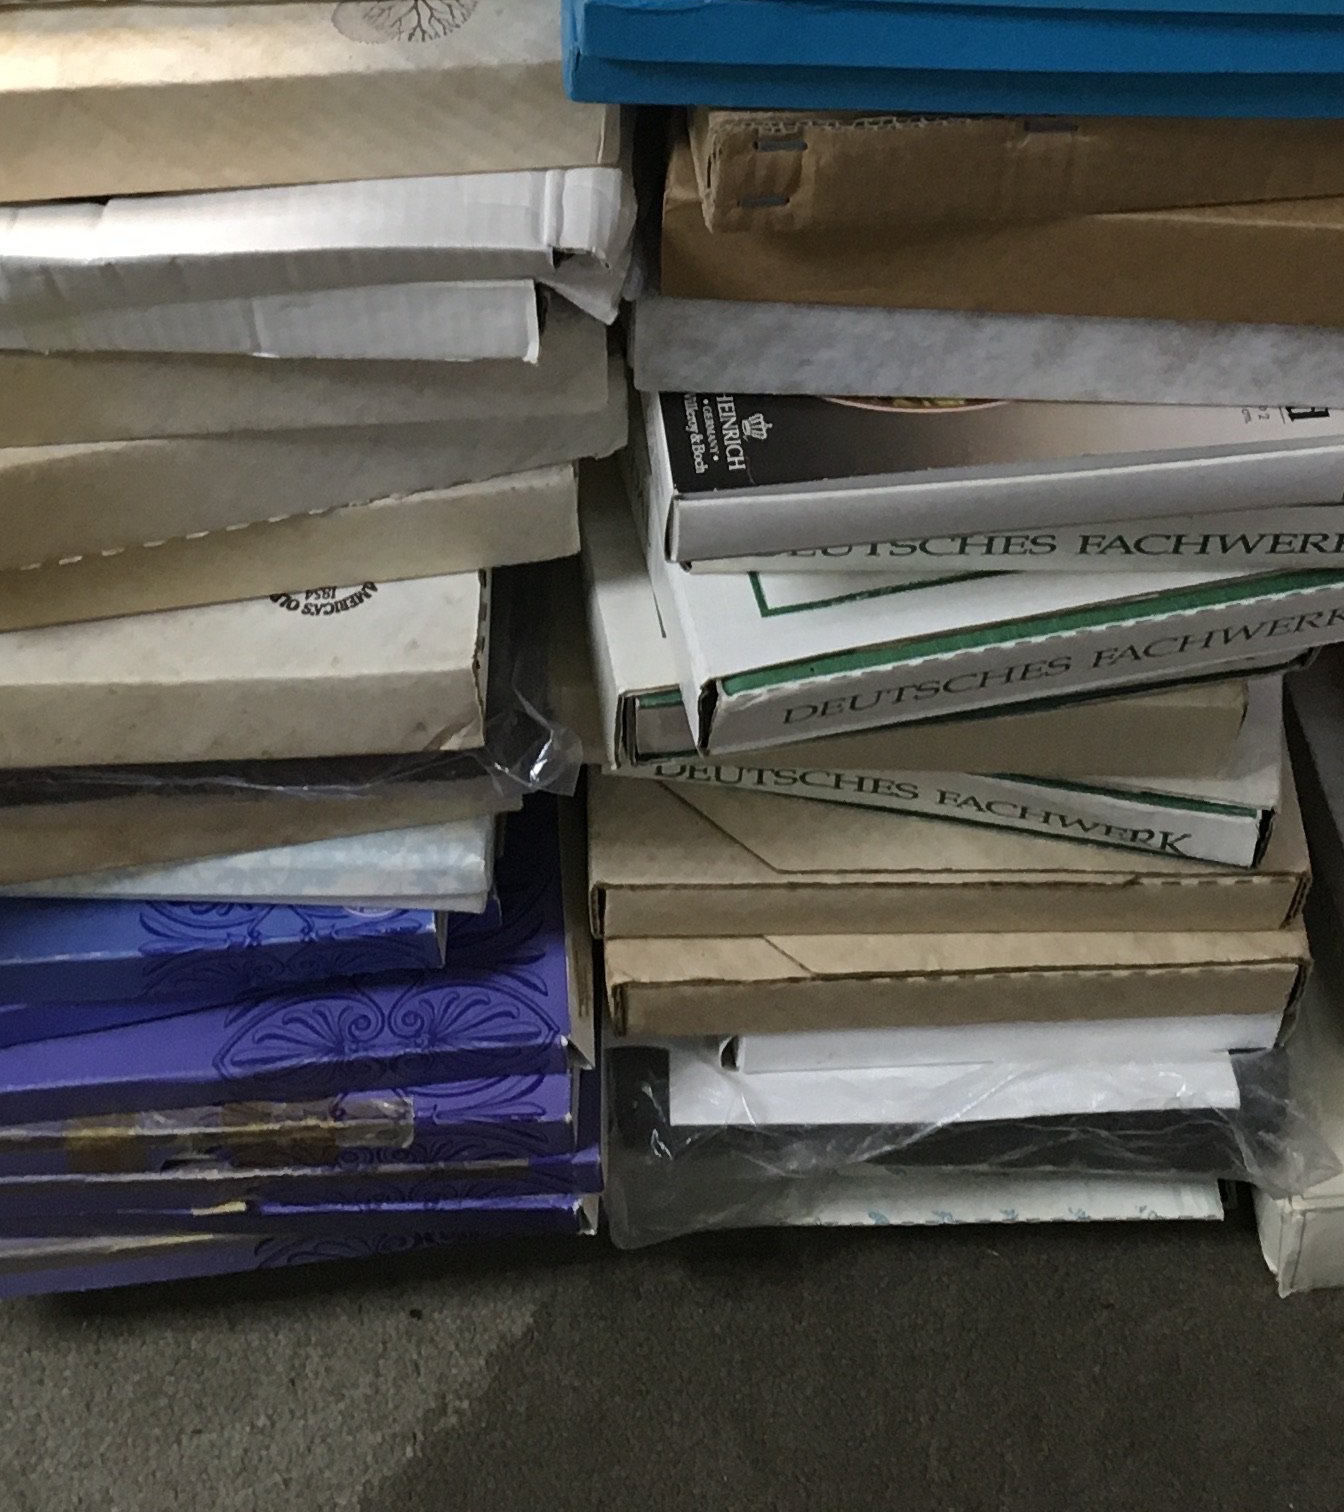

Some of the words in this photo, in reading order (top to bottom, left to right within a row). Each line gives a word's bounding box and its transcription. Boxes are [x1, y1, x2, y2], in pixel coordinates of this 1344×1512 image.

[690, 433, 704, 445] &
[702, 405, 720, 455] GERMANY
[716, 393, 746, 471] HEINRICH
[691, 444, 709, 474] Boch
[787, 534, 1057, 557] UTSCHES
[301, 581, 378, 616] AMERICA'S
[782, 656, 1072, 726] DEUTSCHES
[654, 764, 920, 801] DEUTSCHES
[935, 789, 1192, 855] FACHWERK
